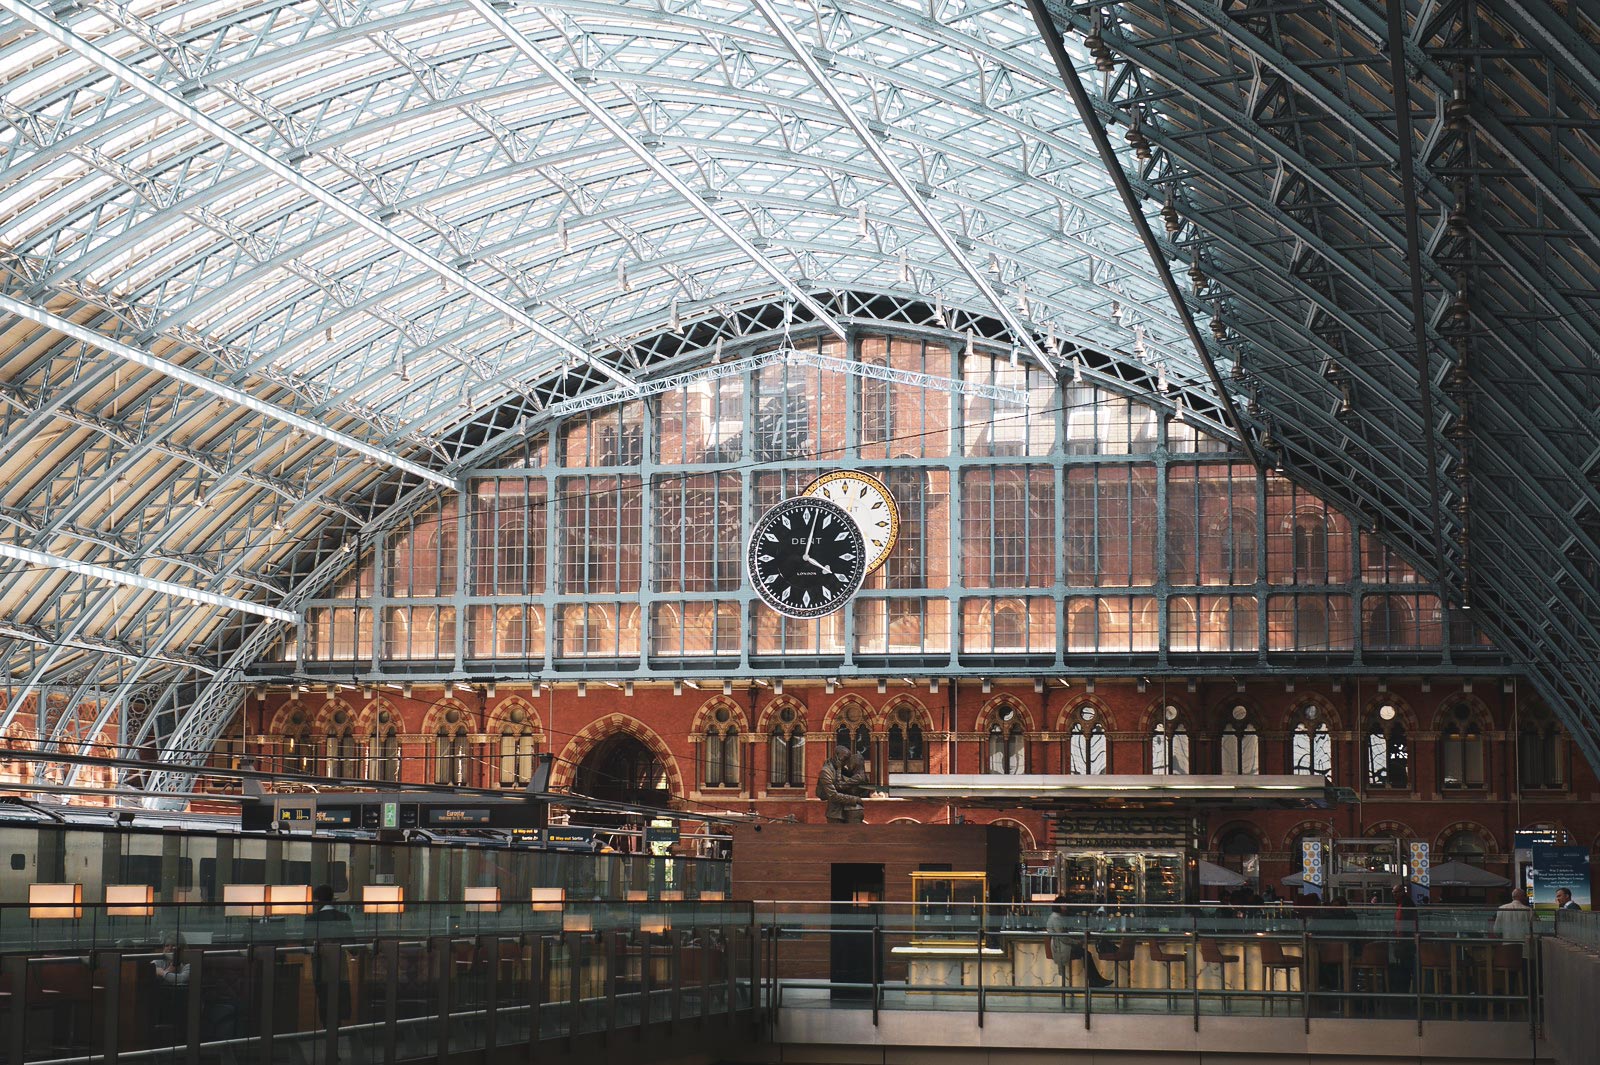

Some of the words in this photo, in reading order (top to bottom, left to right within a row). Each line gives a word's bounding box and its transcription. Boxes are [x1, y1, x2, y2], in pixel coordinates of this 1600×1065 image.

[791, 537, 822, 545] DENT
[1058, 816, 1180, 834] SEARCYS
[1065, 838, 1148, 849] CHAMPAGNE
